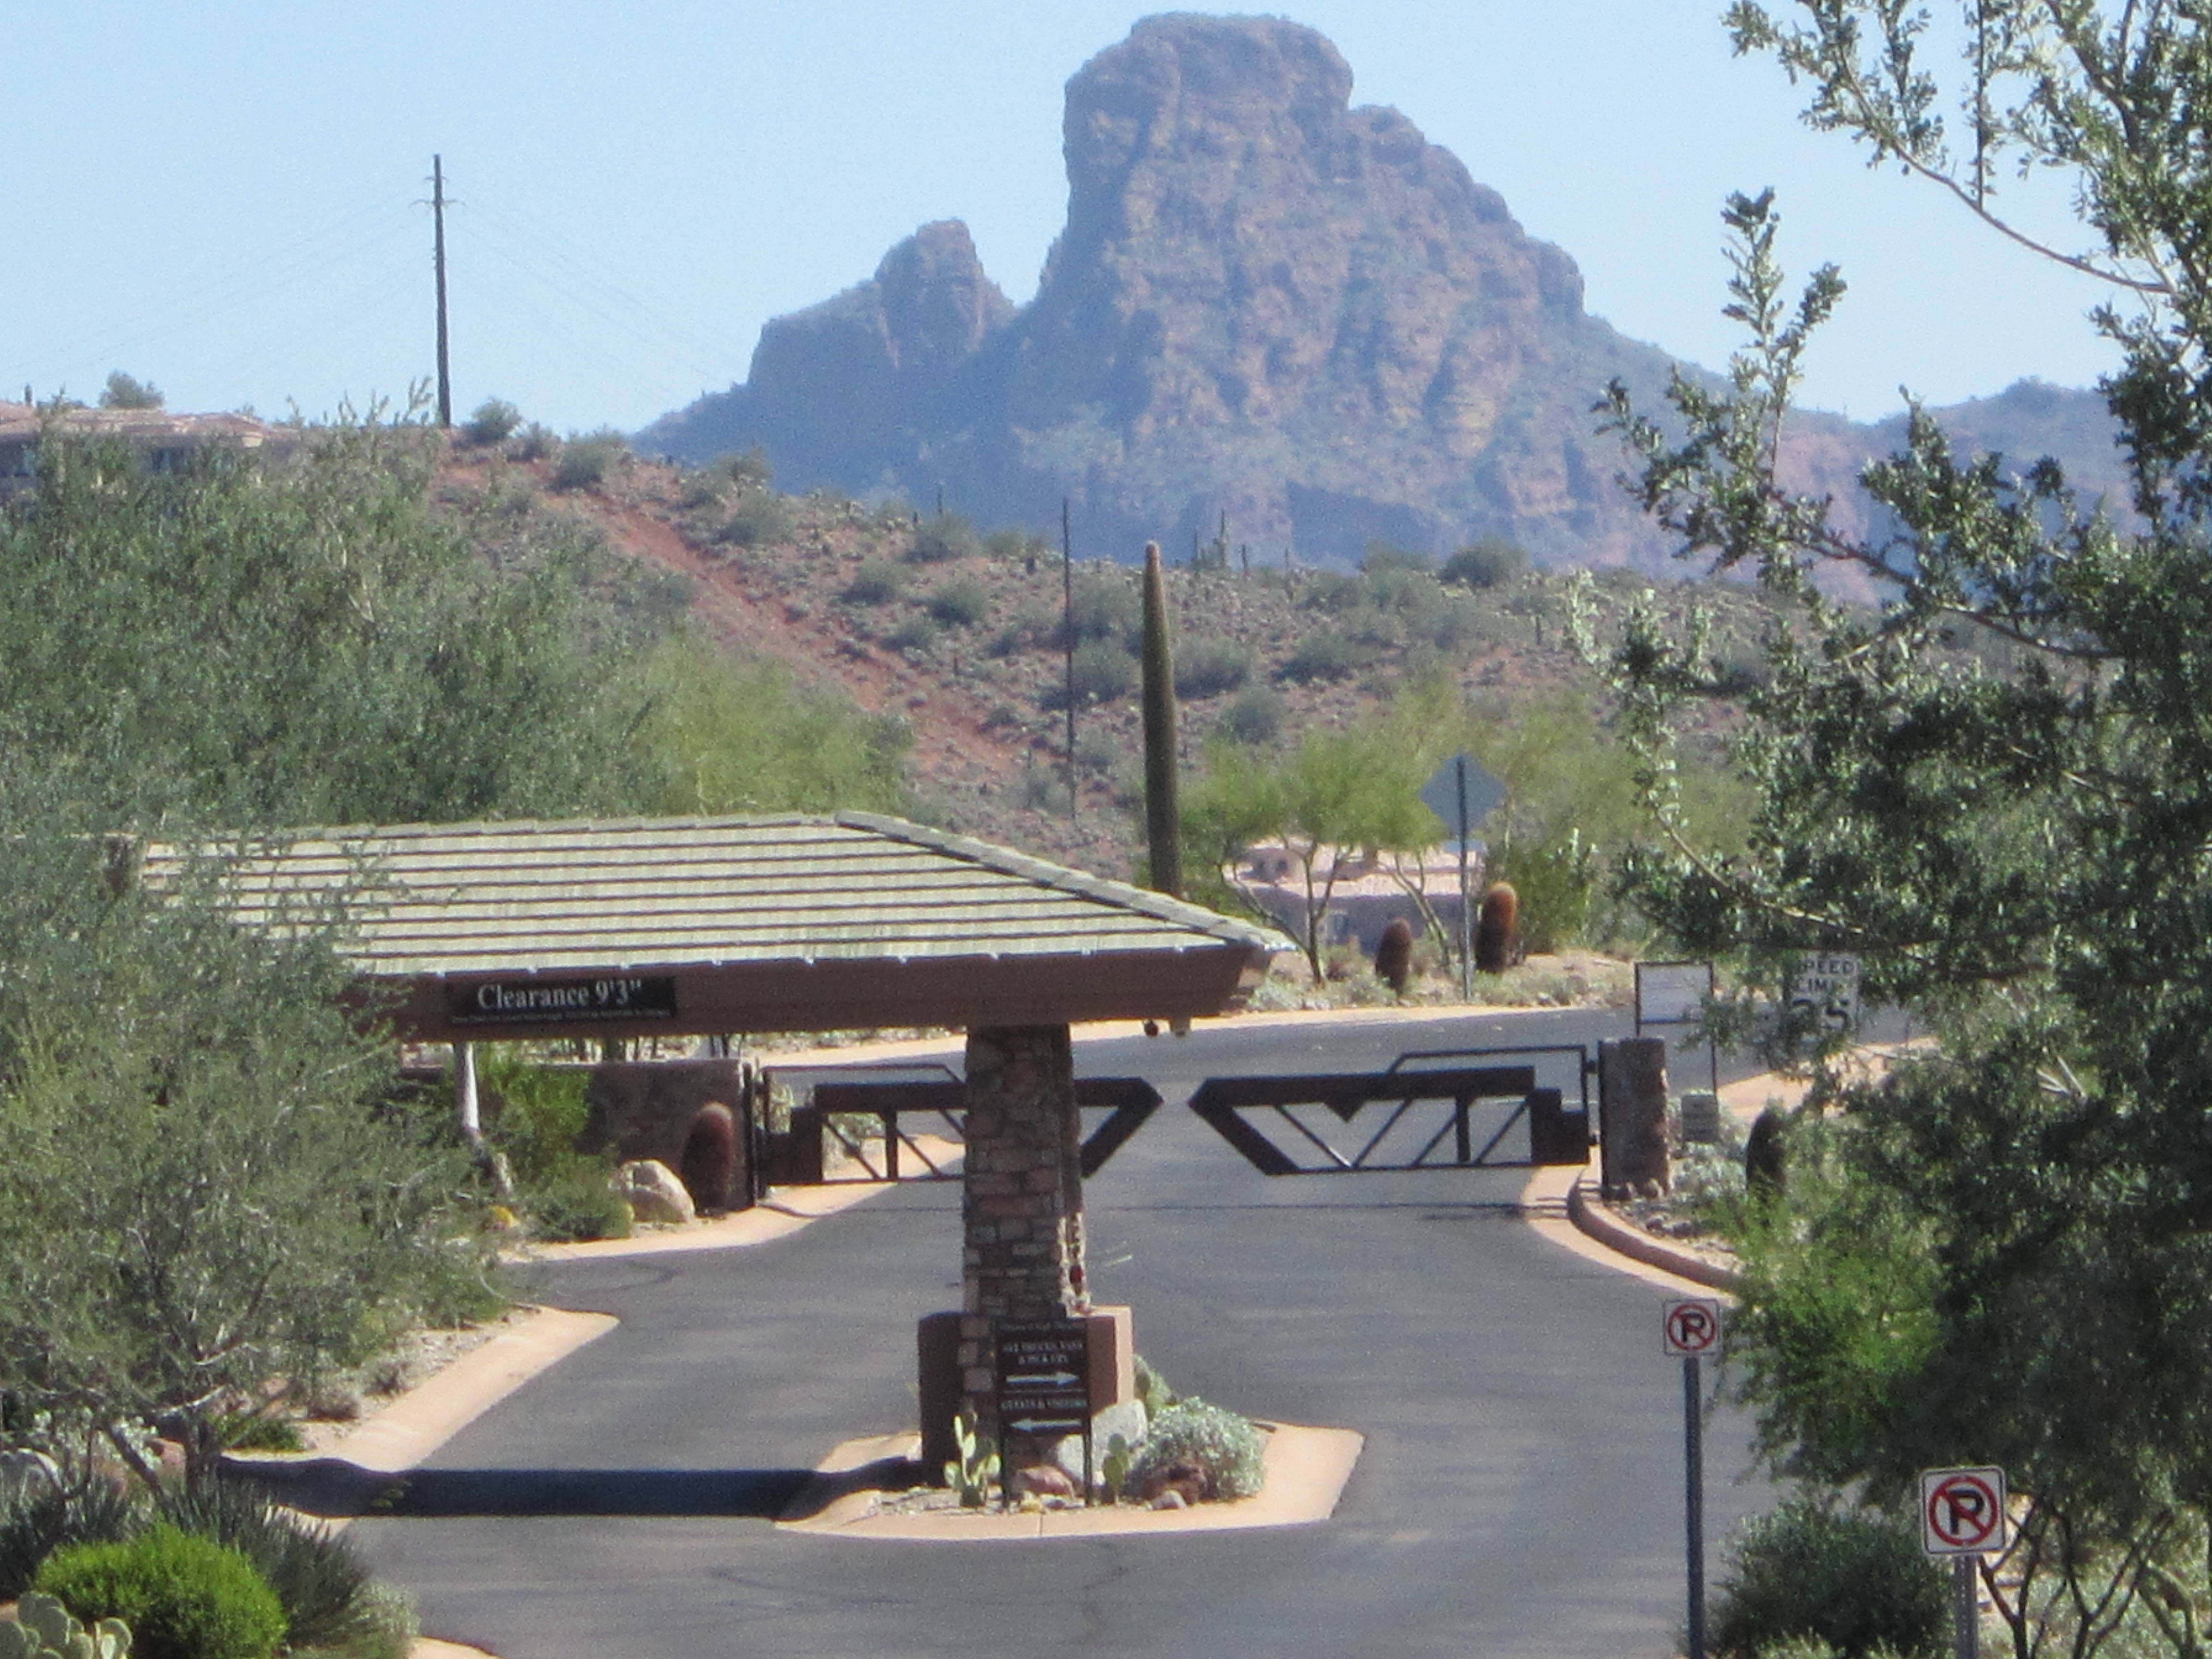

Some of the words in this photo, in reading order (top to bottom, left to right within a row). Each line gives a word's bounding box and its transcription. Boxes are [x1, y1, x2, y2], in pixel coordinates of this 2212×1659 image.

[1800, 959, 1854, 974] PEED
[478, 983, 589, 1009] Clearance
[595, 978, 642, 1005] 9'3"
